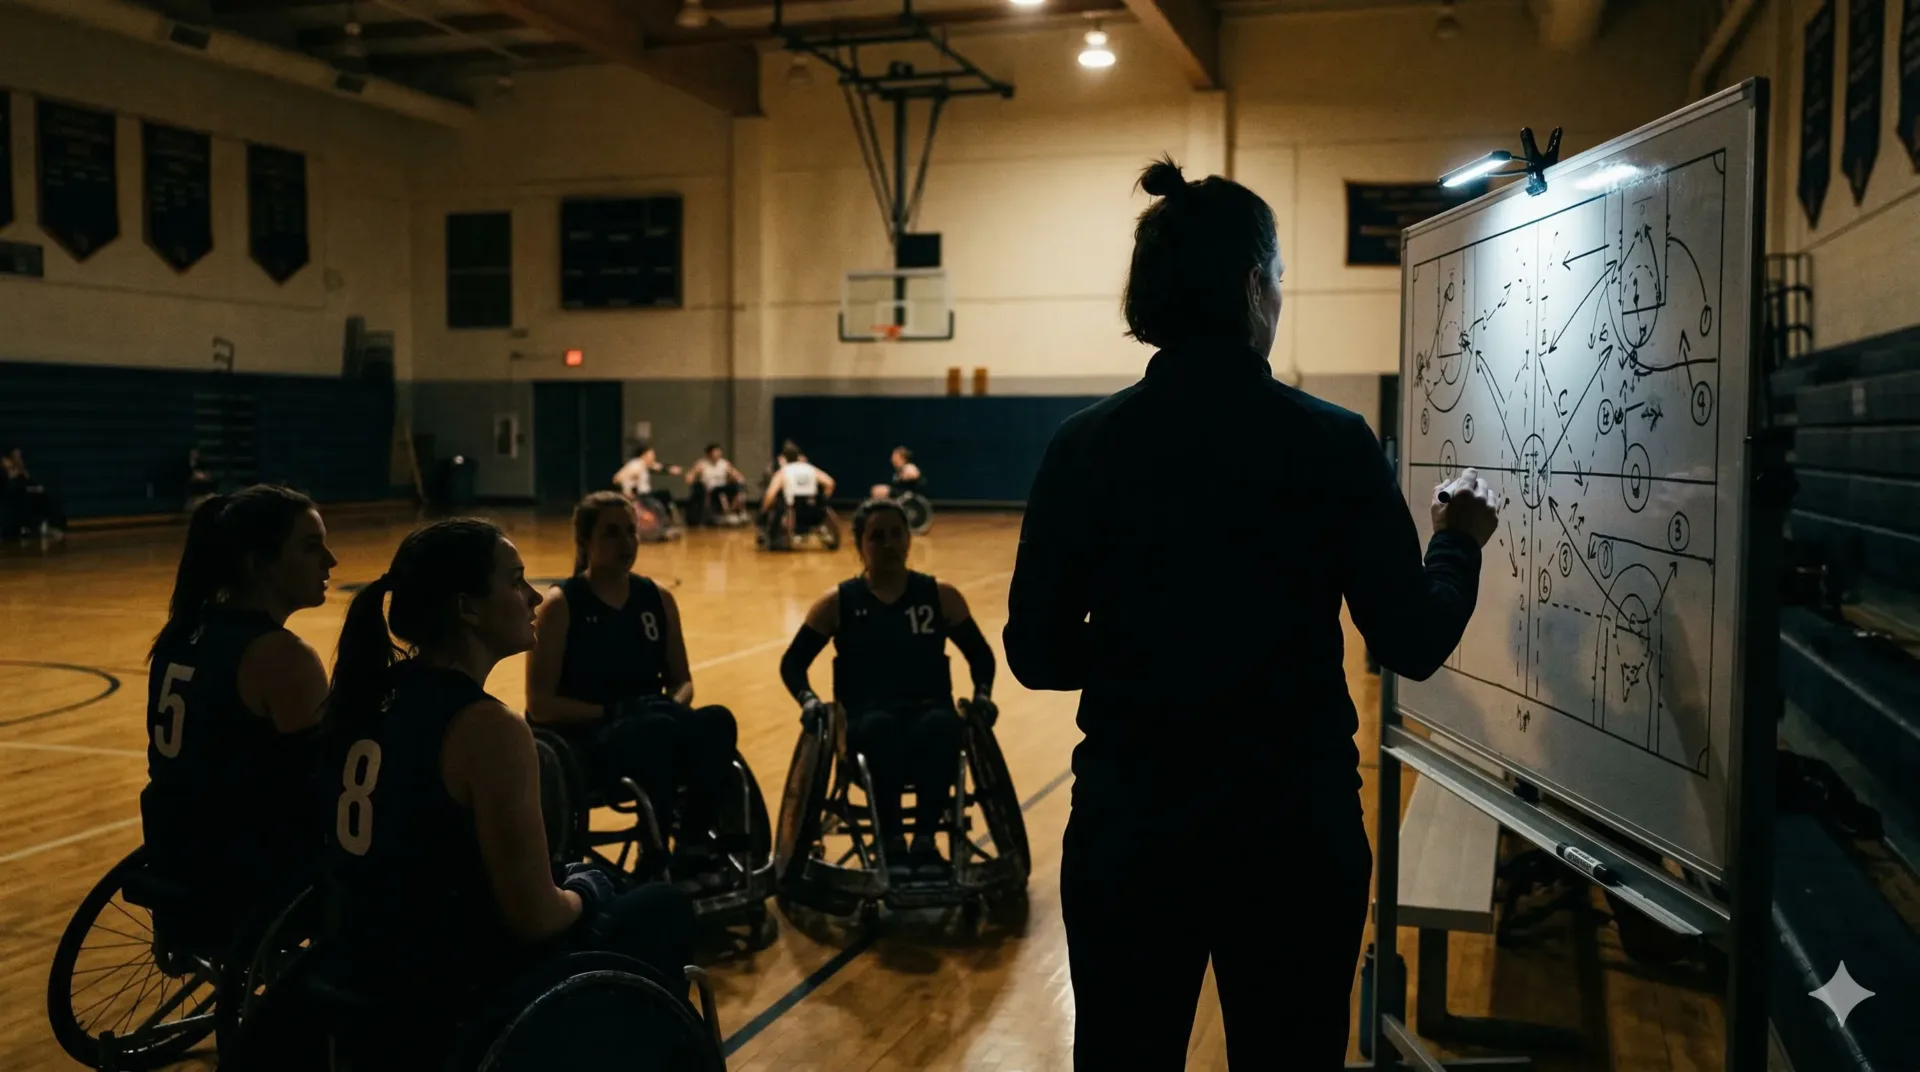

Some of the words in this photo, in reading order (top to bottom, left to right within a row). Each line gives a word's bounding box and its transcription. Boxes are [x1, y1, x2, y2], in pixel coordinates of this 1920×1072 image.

[639, 611, 661, 642] 8
[904, 604, 936, 635] 12
[154, 661, 196, 760] 5
[336, 737, 383, 857] 8
